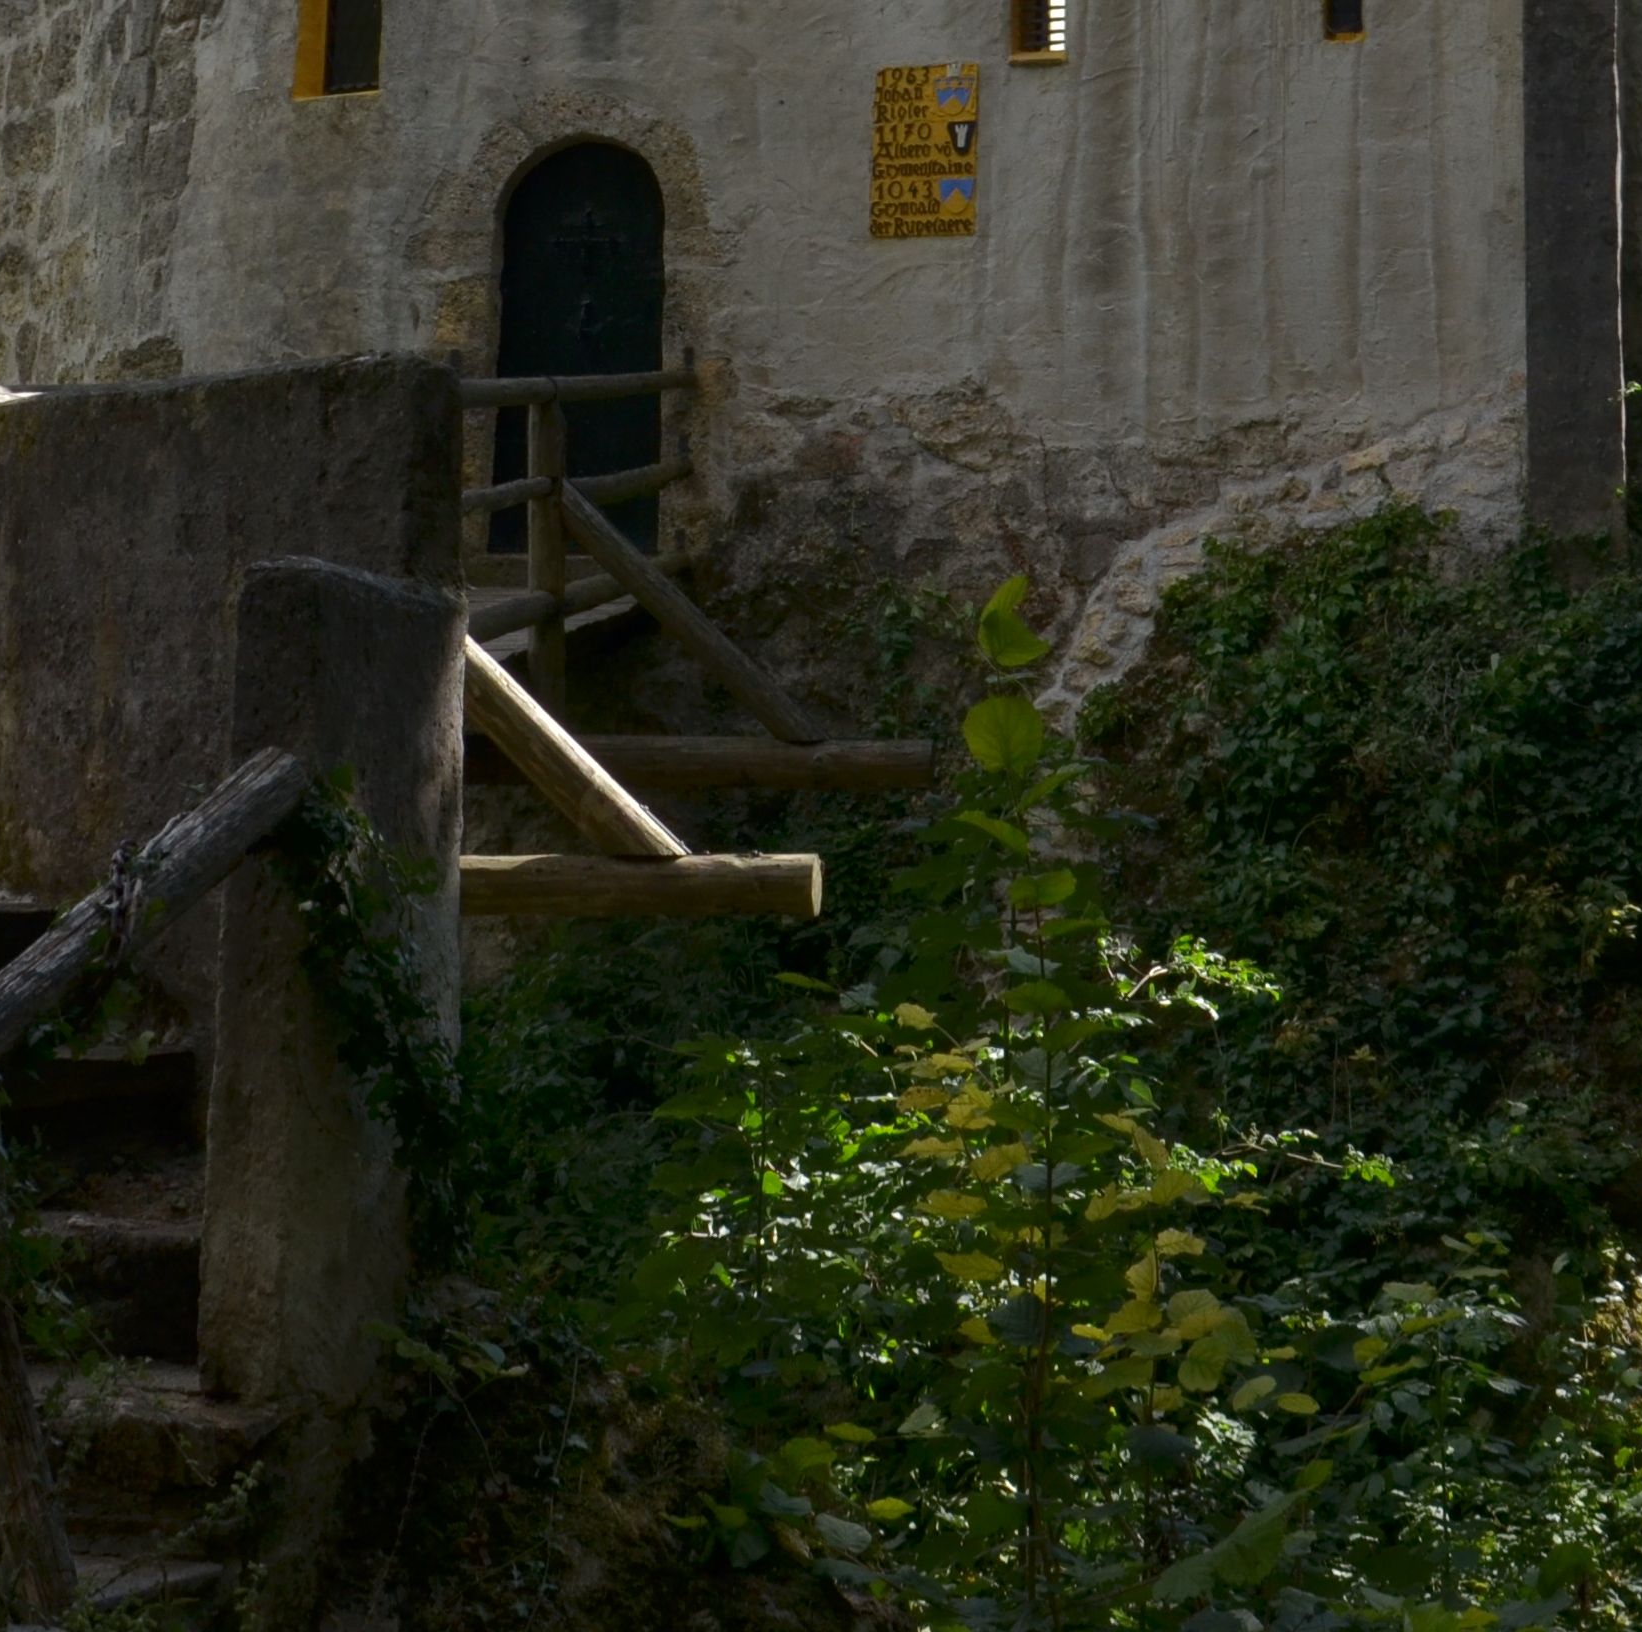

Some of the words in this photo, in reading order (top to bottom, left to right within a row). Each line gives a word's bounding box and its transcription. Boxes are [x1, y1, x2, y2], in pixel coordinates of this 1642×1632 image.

[877, 67, 930, 87] 1963
[876, 123, 932, 142] 1170
[874, 142, 931, 161] Albero
[875, 180, 934, 200] 1043
[869, 219, 893, 238] der
